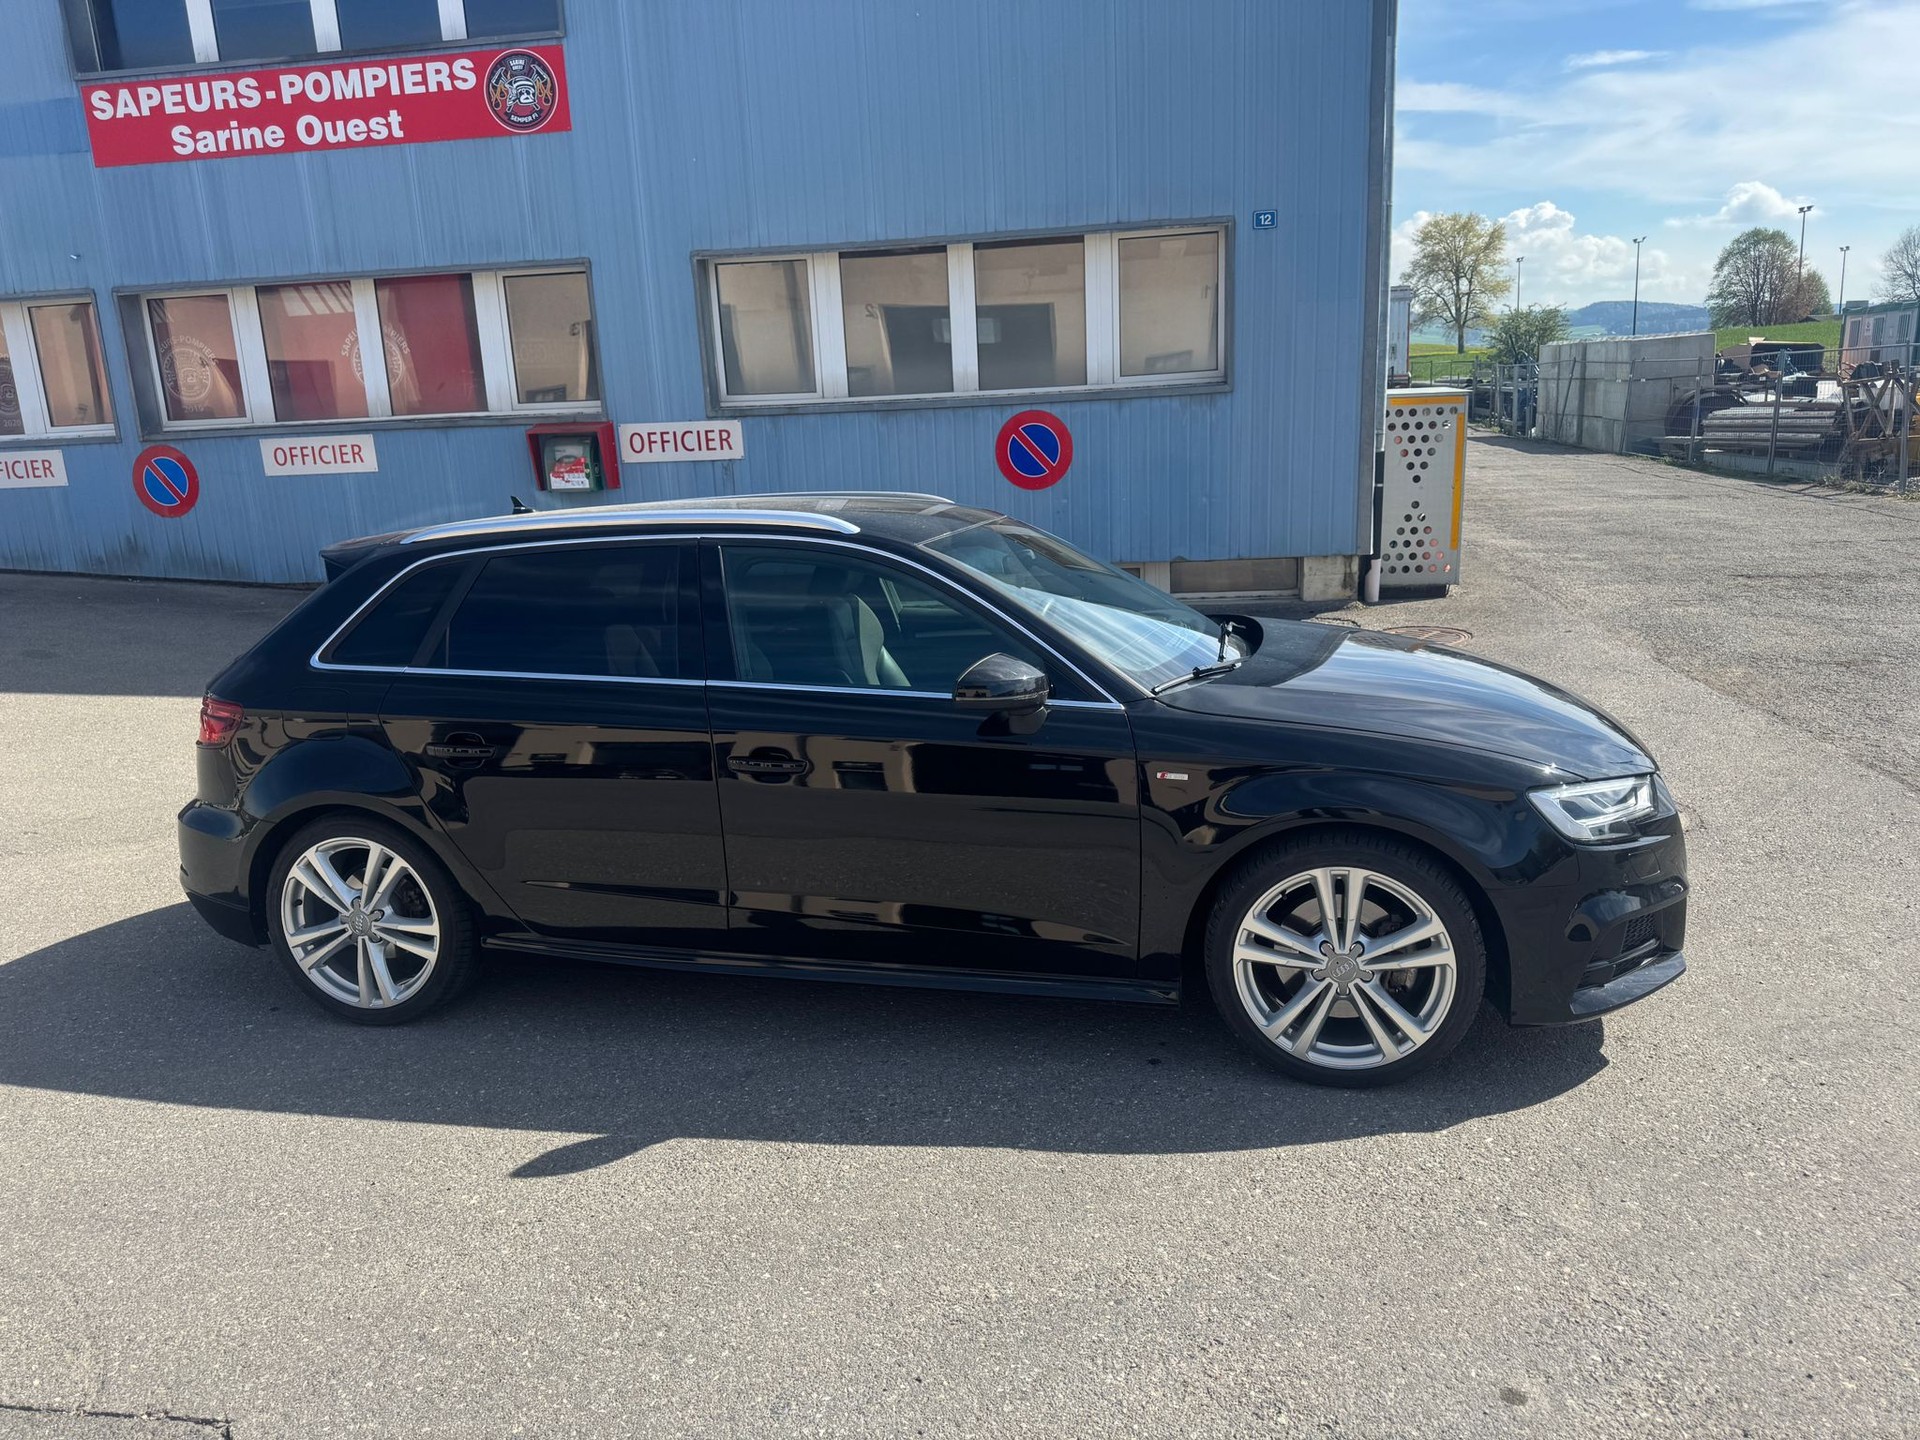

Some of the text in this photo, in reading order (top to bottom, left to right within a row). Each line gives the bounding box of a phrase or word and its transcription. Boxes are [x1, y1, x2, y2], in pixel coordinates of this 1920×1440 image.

[90, 58, 477, 120] SAPEURS-POMPIERS
[171, 109, 404, 155] Sarine Ouest
[1259, 214, 1272, 225] 12
[629, 429, 733, 454] OFFICIER
[273, 444, 365, 466] OFFICIER
